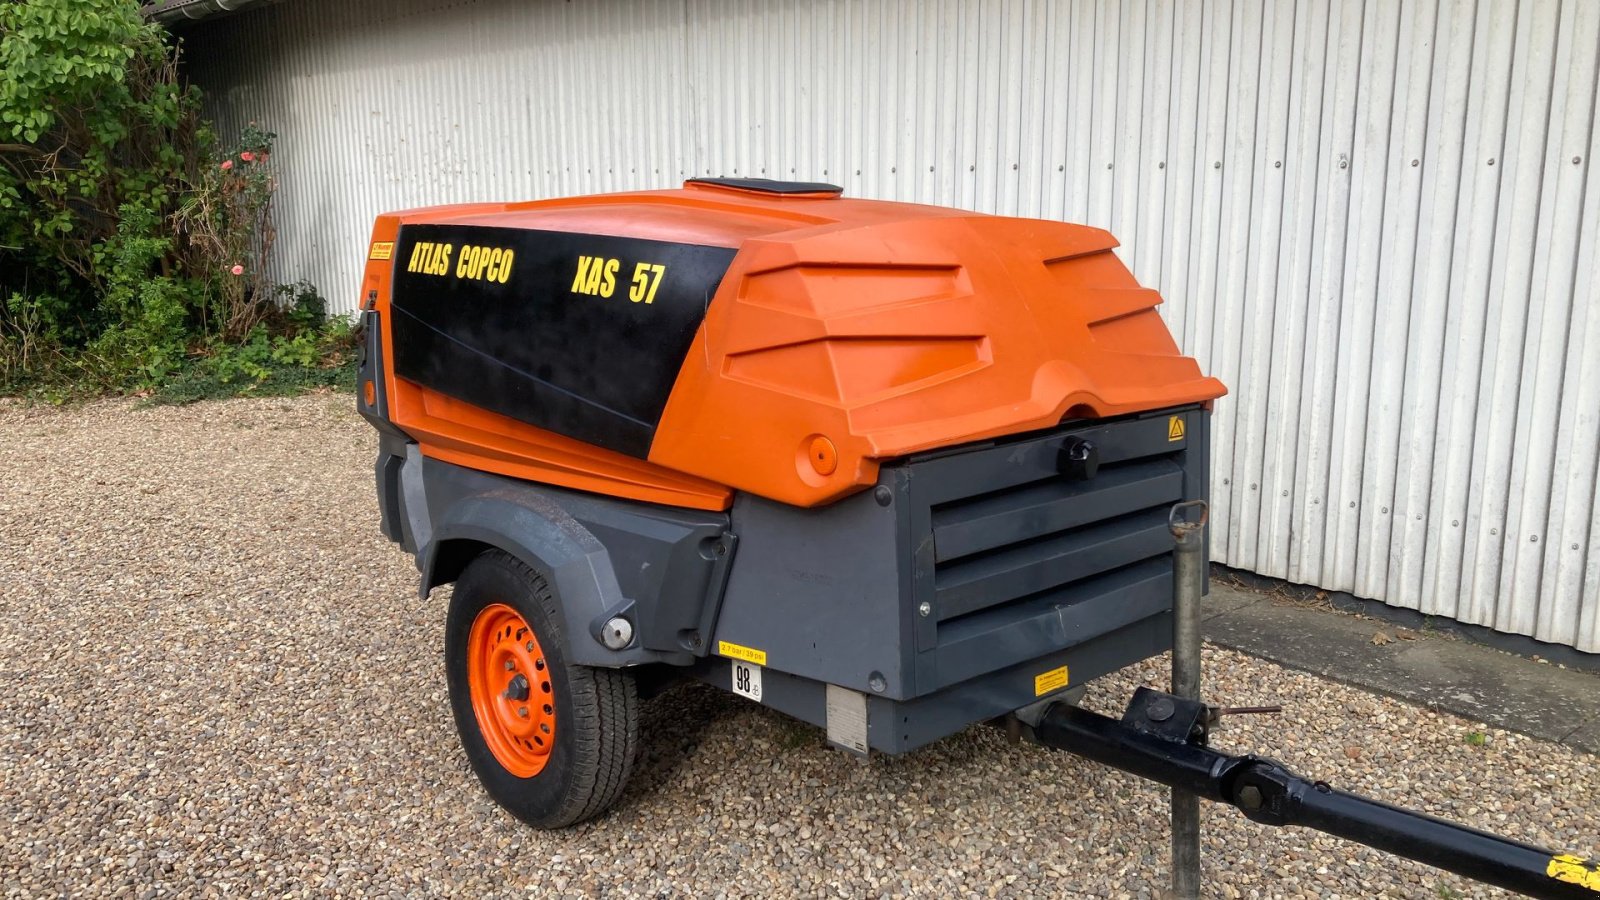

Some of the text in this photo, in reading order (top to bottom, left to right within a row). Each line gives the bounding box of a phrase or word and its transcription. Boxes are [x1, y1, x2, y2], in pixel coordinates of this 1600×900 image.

[408, 241, 514, 284] ATLAS COPCO
[570, 255, 666, 304] XAS 57
[755, 653, 764, 661] psi
[736, 665, 750, 693] 98
